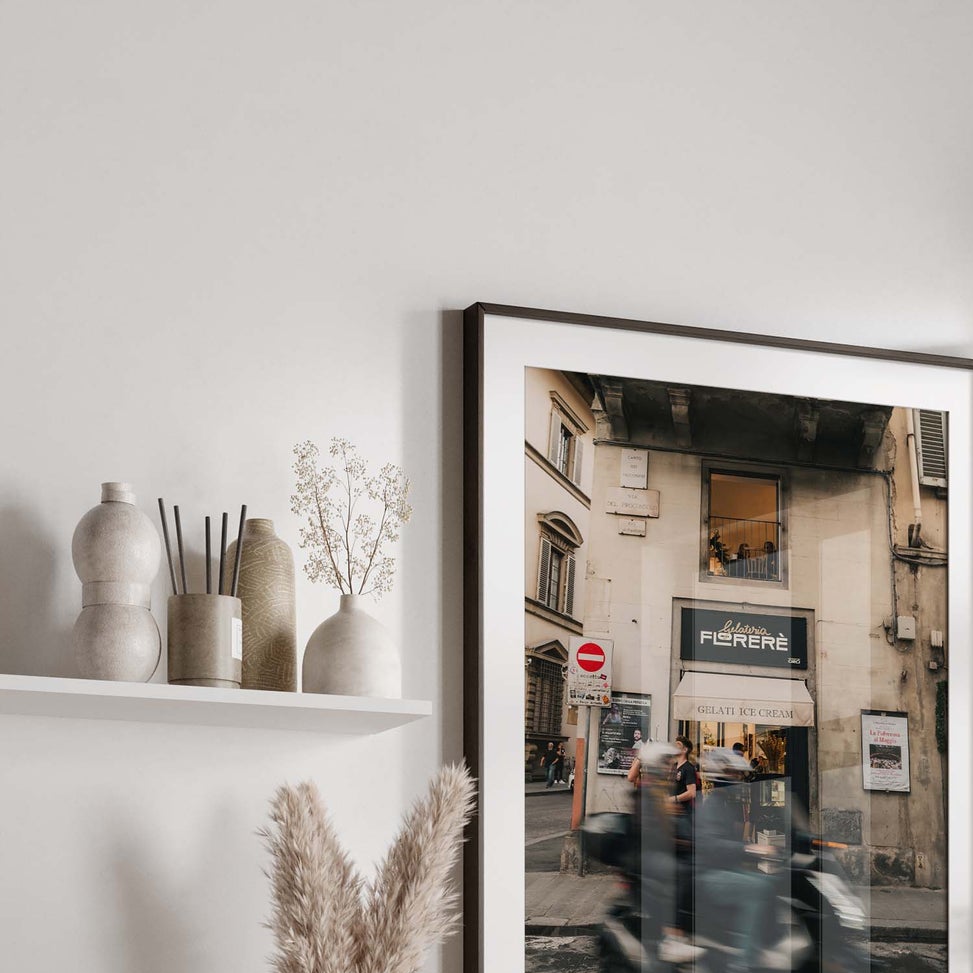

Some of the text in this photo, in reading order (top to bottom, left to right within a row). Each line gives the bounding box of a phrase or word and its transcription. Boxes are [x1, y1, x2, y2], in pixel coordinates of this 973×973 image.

[718, 620, 771, 636] Gelateria
[700, 631, 788, 651] FLORERÈ
[697, 705, 794, 719] GELATI ICE CREAM
